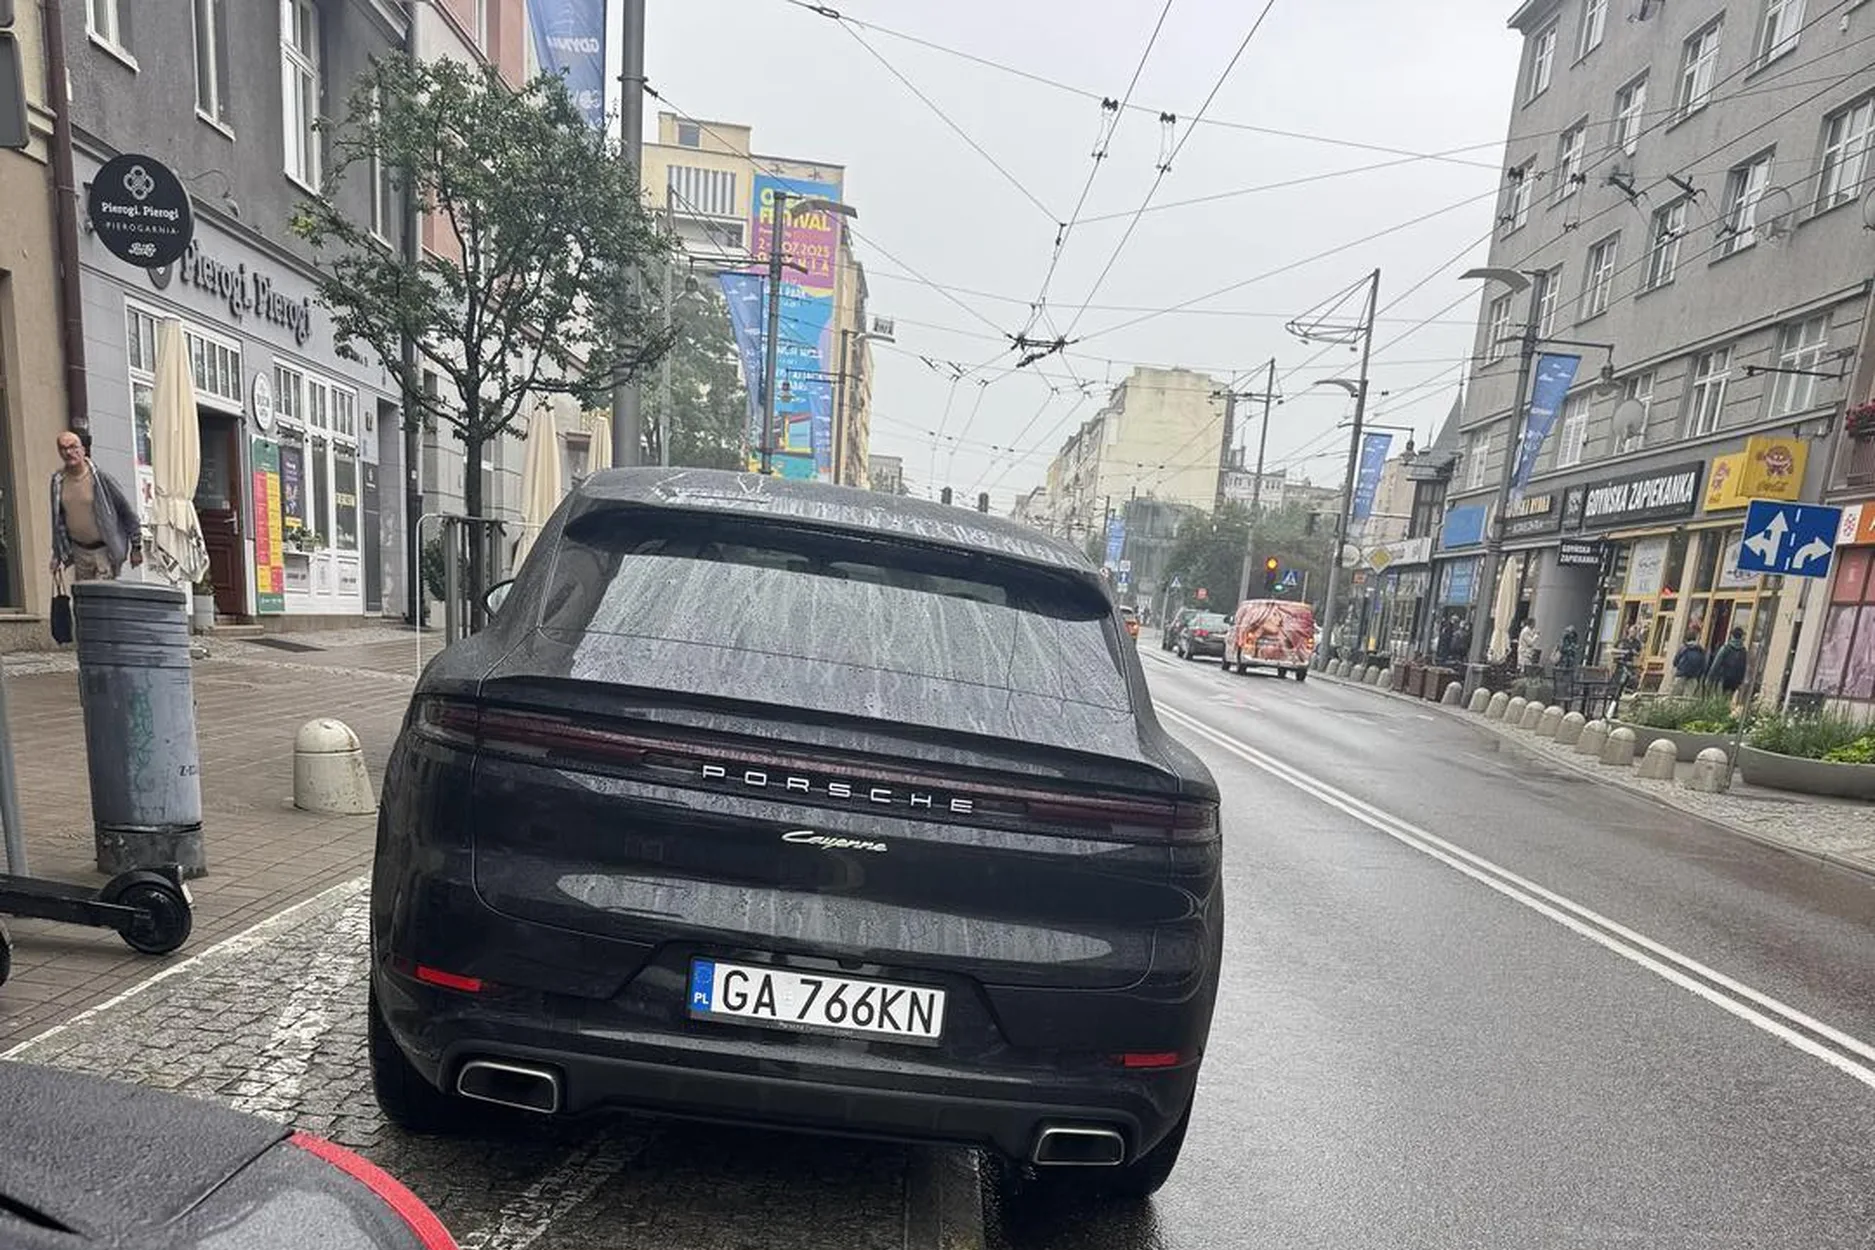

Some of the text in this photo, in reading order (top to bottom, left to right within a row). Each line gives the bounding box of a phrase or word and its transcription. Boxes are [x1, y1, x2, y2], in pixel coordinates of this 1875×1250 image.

[1585, 481, 1629, 517] GDYŃSKA
[1628, 472, 1696, 512] ZAPIEKANKA
[702, 764, 974, 815] PORSCHE
[781, 830, 888, 851] Cayenne
[693, 992, 709, 1005] PL
[721, 969, 936, 1034] GA 766KN
